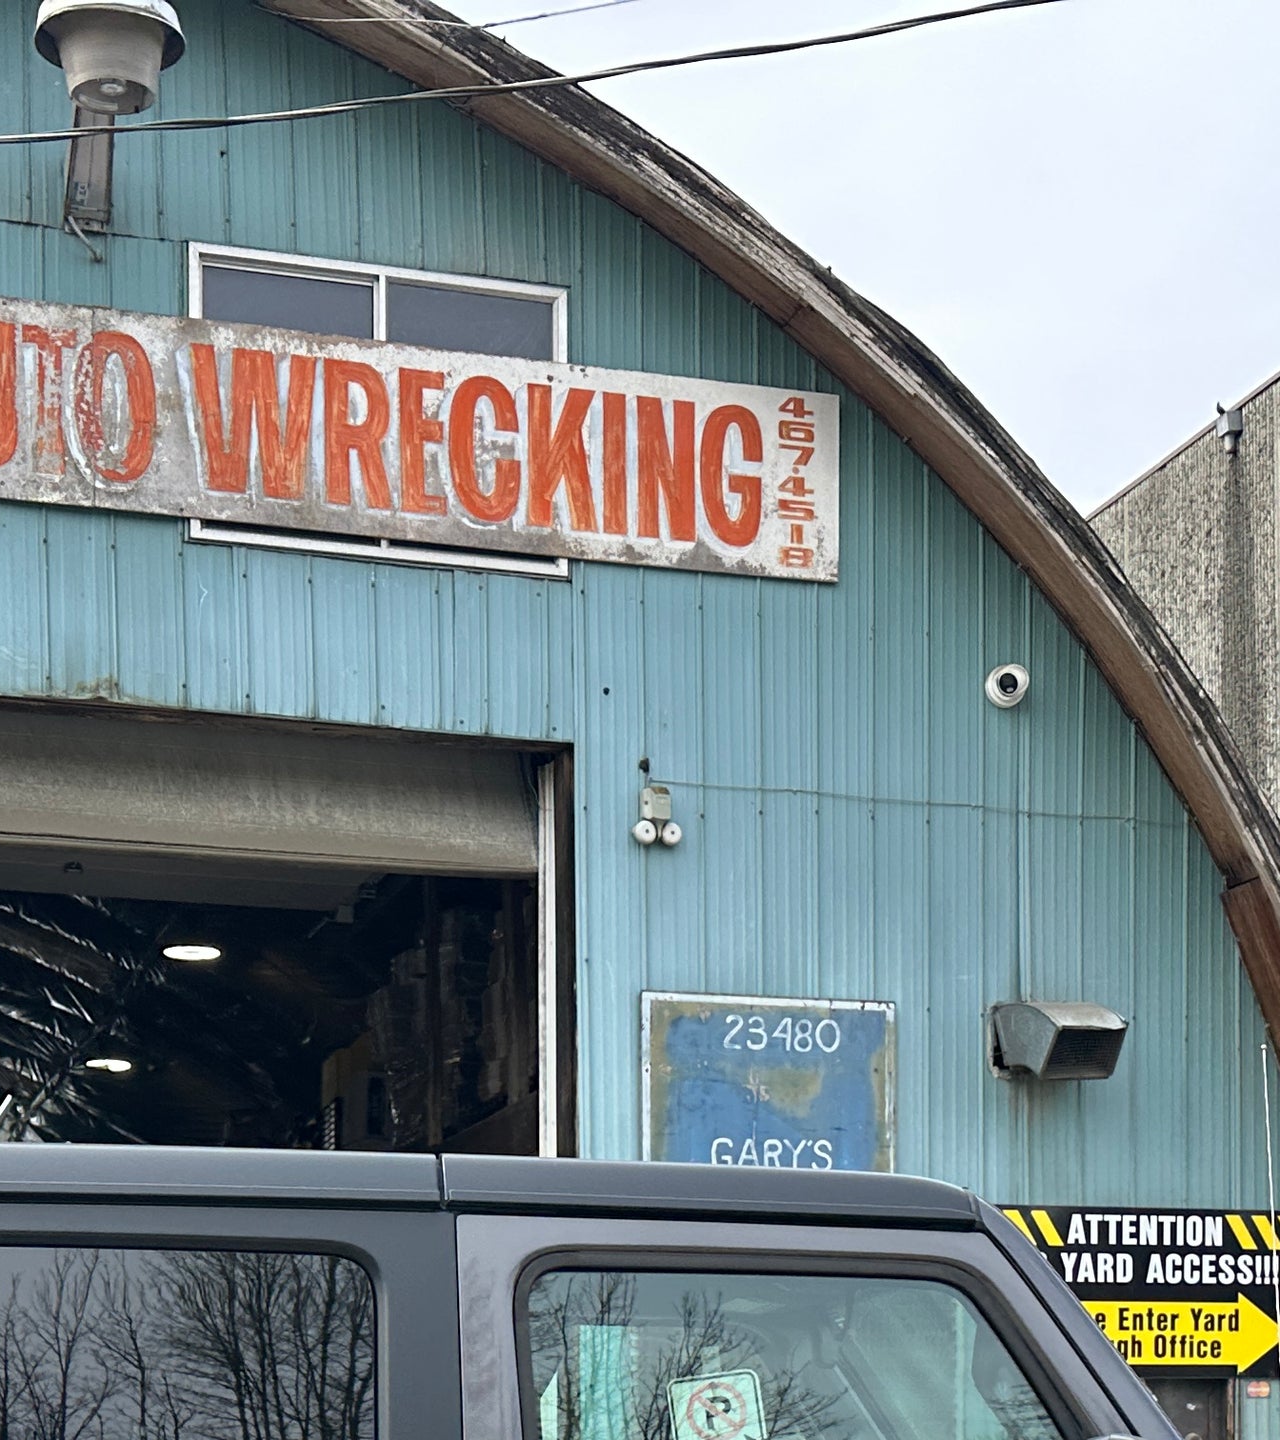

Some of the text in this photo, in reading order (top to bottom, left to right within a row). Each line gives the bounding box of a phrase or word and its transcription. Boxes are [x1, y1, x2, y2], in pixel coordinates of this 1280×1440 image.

[189, 342, 764, 548] WRECKING
[723, 1014, 841, 1053] 23480
[711, 1137, 833, 1170] GARY'S
[1067, 1213, 1223, 1246] ATTENTION
[1061, 1251, 1280, 1285] YARD ACCESS!!!
[1118, 1307, 1180, 1332] Enter
[1191, 1308, 1240, 1332] Yard
[1153, 1336, 1222, 1358] Office
